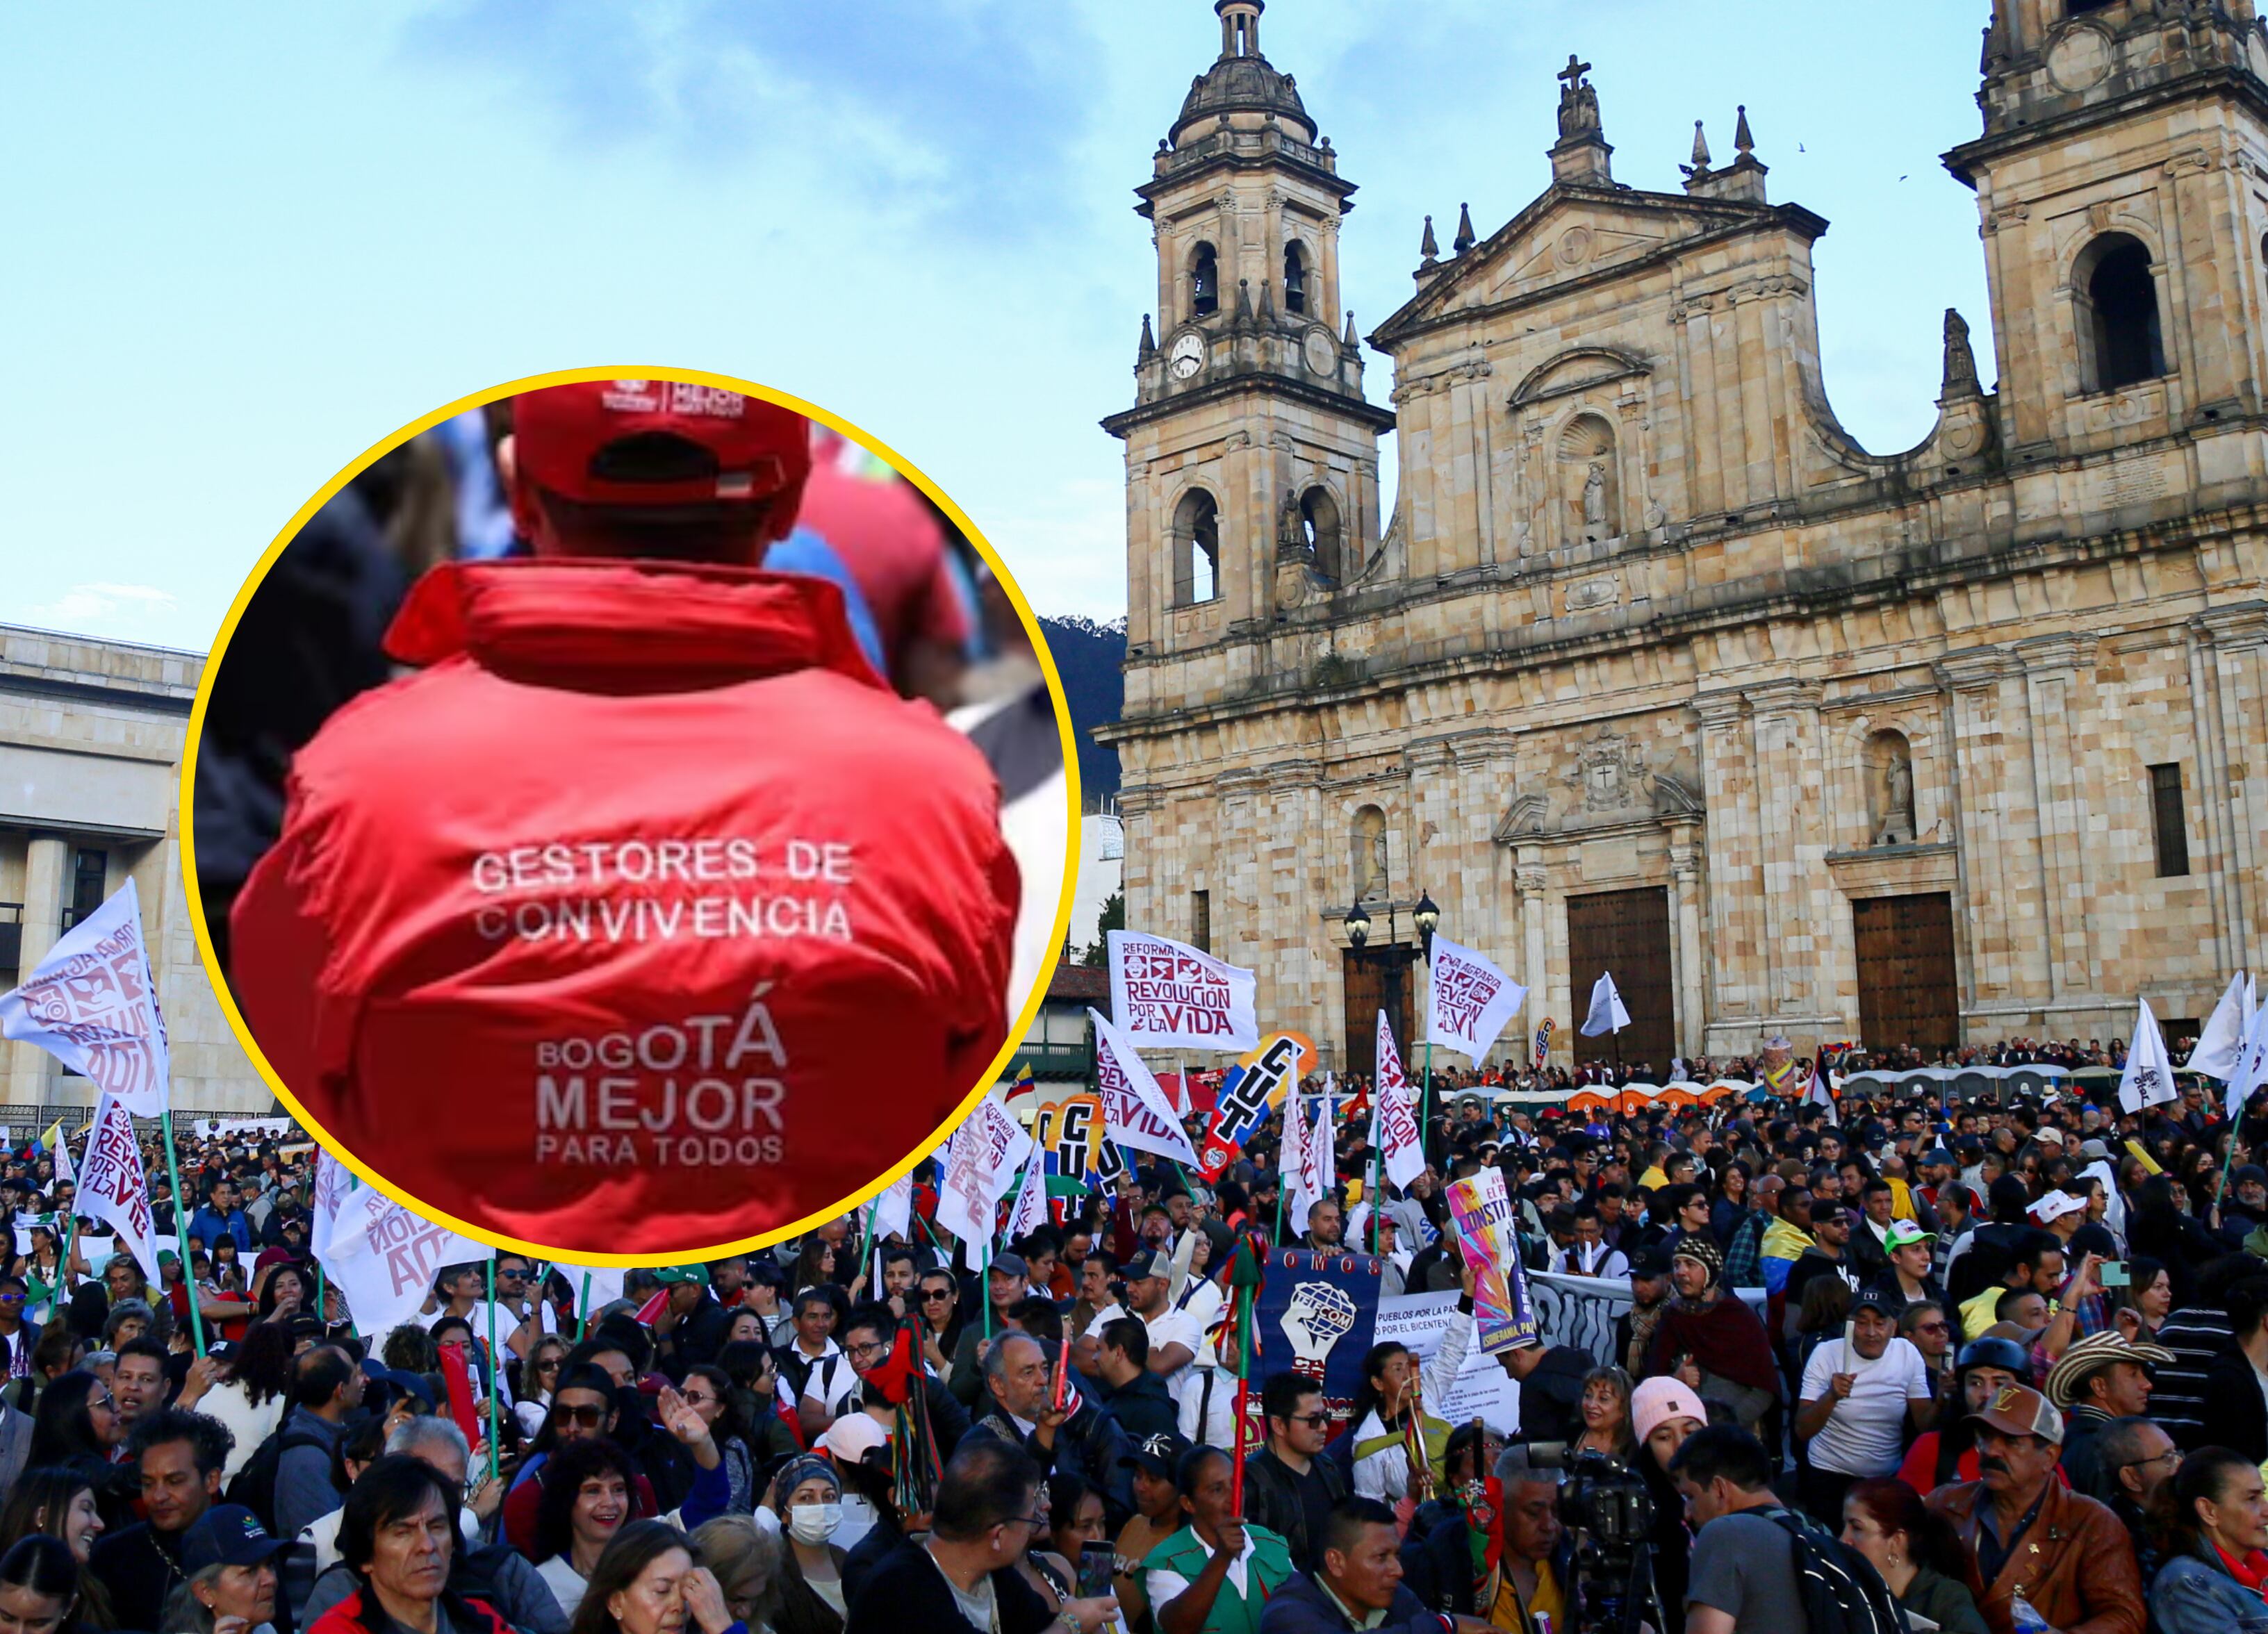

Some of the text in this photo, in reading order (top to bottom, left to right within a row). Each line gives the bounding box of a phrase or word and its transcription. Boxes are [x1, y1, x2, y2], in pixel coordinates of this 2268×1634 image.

[472, 840, 853, 894] GESTORES DE
[475, 896, 853, 943] CONVIVENCIA
[1122, 943, 1175, 956] REFORMA
[1461, 962, 1502, 991] AGRARIA
[1126, 981, 1231, 1009] REVOLUCIÓN
[1128, 1003, 1156, 1018] POR
[1149, 1018, 1167, 1032] LA
[536, 981, 787, 1071] BOGOTÁ
[1215, 1037, 1305, 1143] CUT
[535, 1078, 785, 1132] MEJOR
[985, 1102, 1016, 1140] AGRARIA
[536, 1136, 784, 1166] PARA TODOS
[1262, 1251, 1382, 1276] OMOS
[1378, 1310, 1414, 1323] PUEBLOS
[1414, 1308, 1430, 1318] POR
[1432, 1306, 1443, 1317] LA
[1382, 1323, 1399, 1335] POR
[1400, 1323, 1410, 1333] EL
